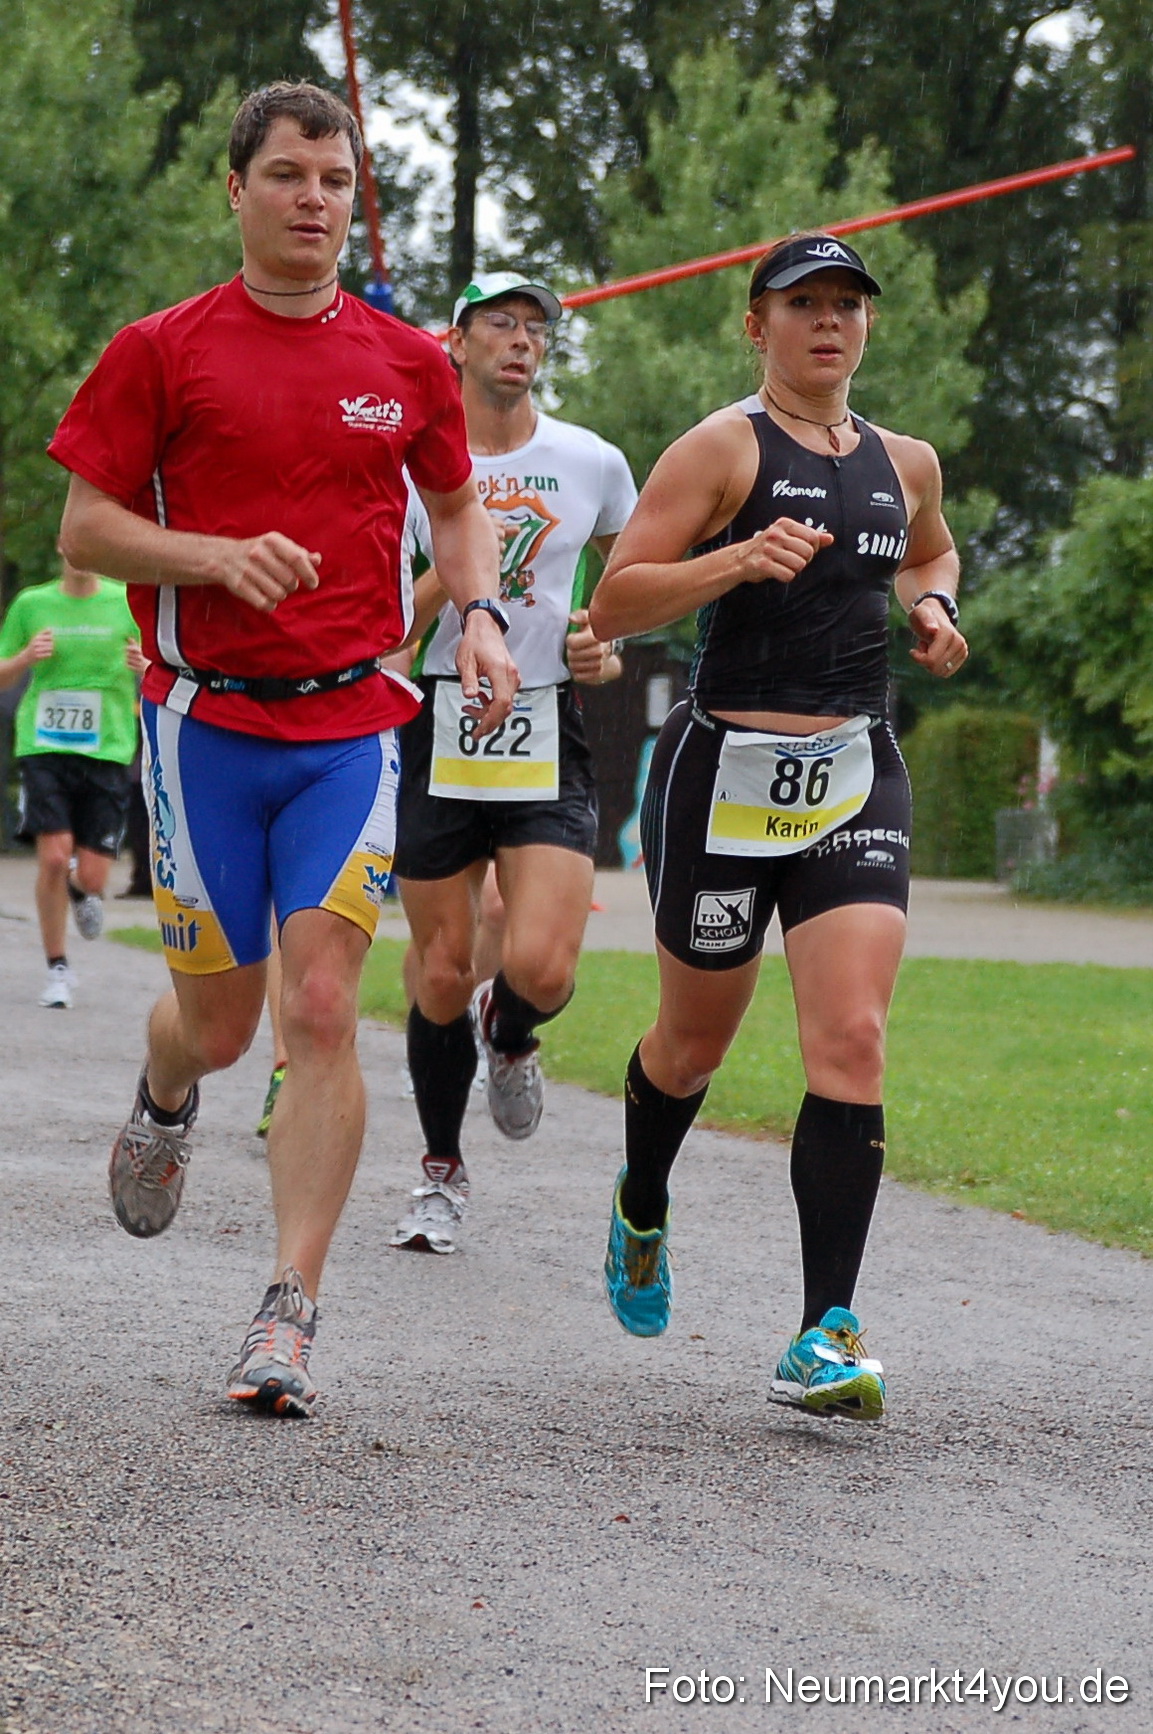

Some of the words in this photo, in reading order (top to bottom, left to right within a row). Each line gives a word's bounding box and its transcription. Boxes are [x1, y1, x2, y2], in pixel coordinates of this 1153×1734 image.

[477, 473, 519, 494] ck'n
[524, 476, 559, 492] run
[43, 708, 94, 730] 3278
[458, 716, 532, 757] 822
[769, 757, 834, 807] 86
[765, 815, 819, 838] Karin
[701, 913, 725, 924] TSV
[700, 924, 743, 939] SCHOTT
